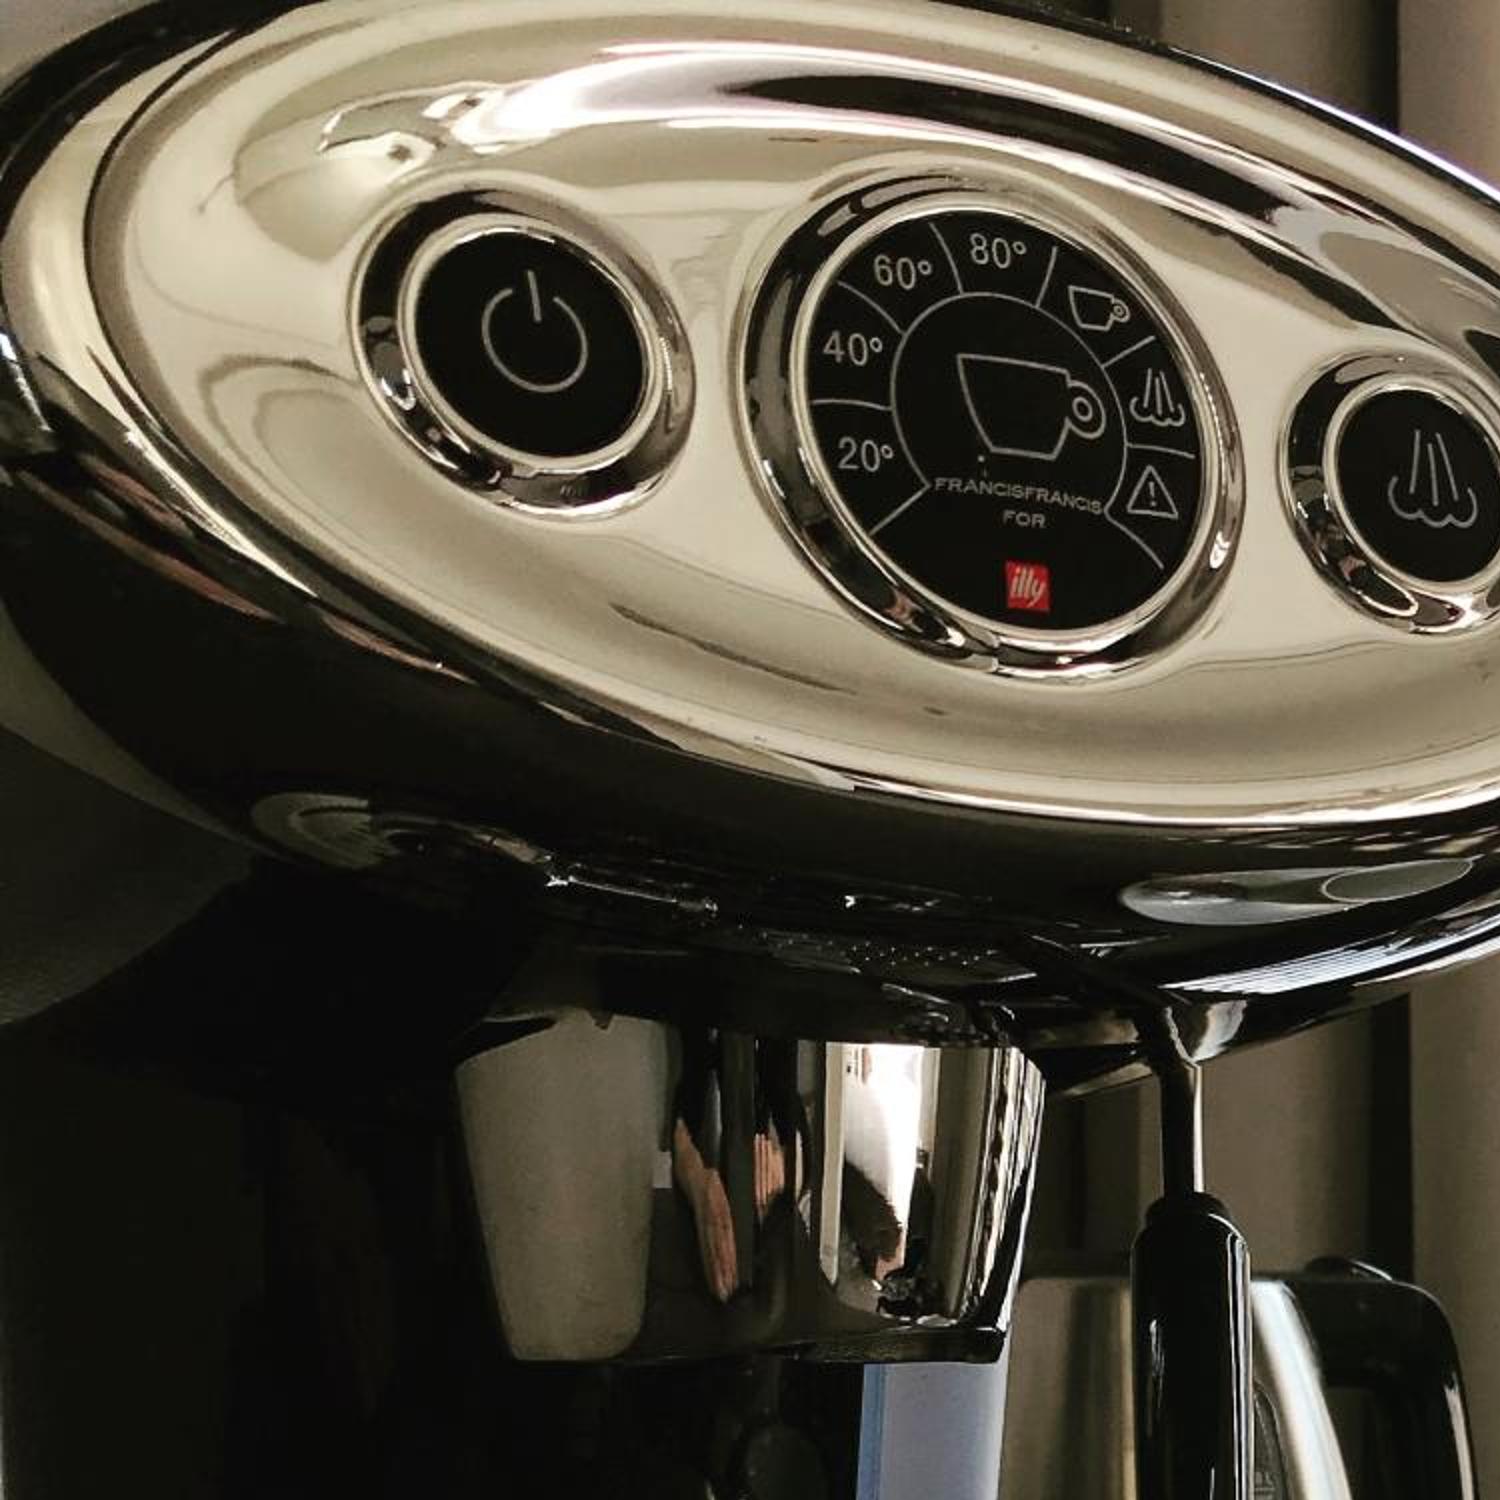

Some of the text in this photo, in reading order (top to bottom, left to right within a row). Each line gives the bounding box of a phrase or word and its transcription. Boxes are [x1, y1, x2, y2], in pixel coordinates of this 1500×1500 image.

[970, 233, 1027, 269] 80°
[873, 255, 934, 290] 60°
[823, 332, 883, 366] 40°
[837, 436, 894, 472] 20°
[934, 476, 1103, 516] FRANCISFRANCIS
[1003, 509, 1047, 529] FOR
[1010, 565, 1047, 608] illy
